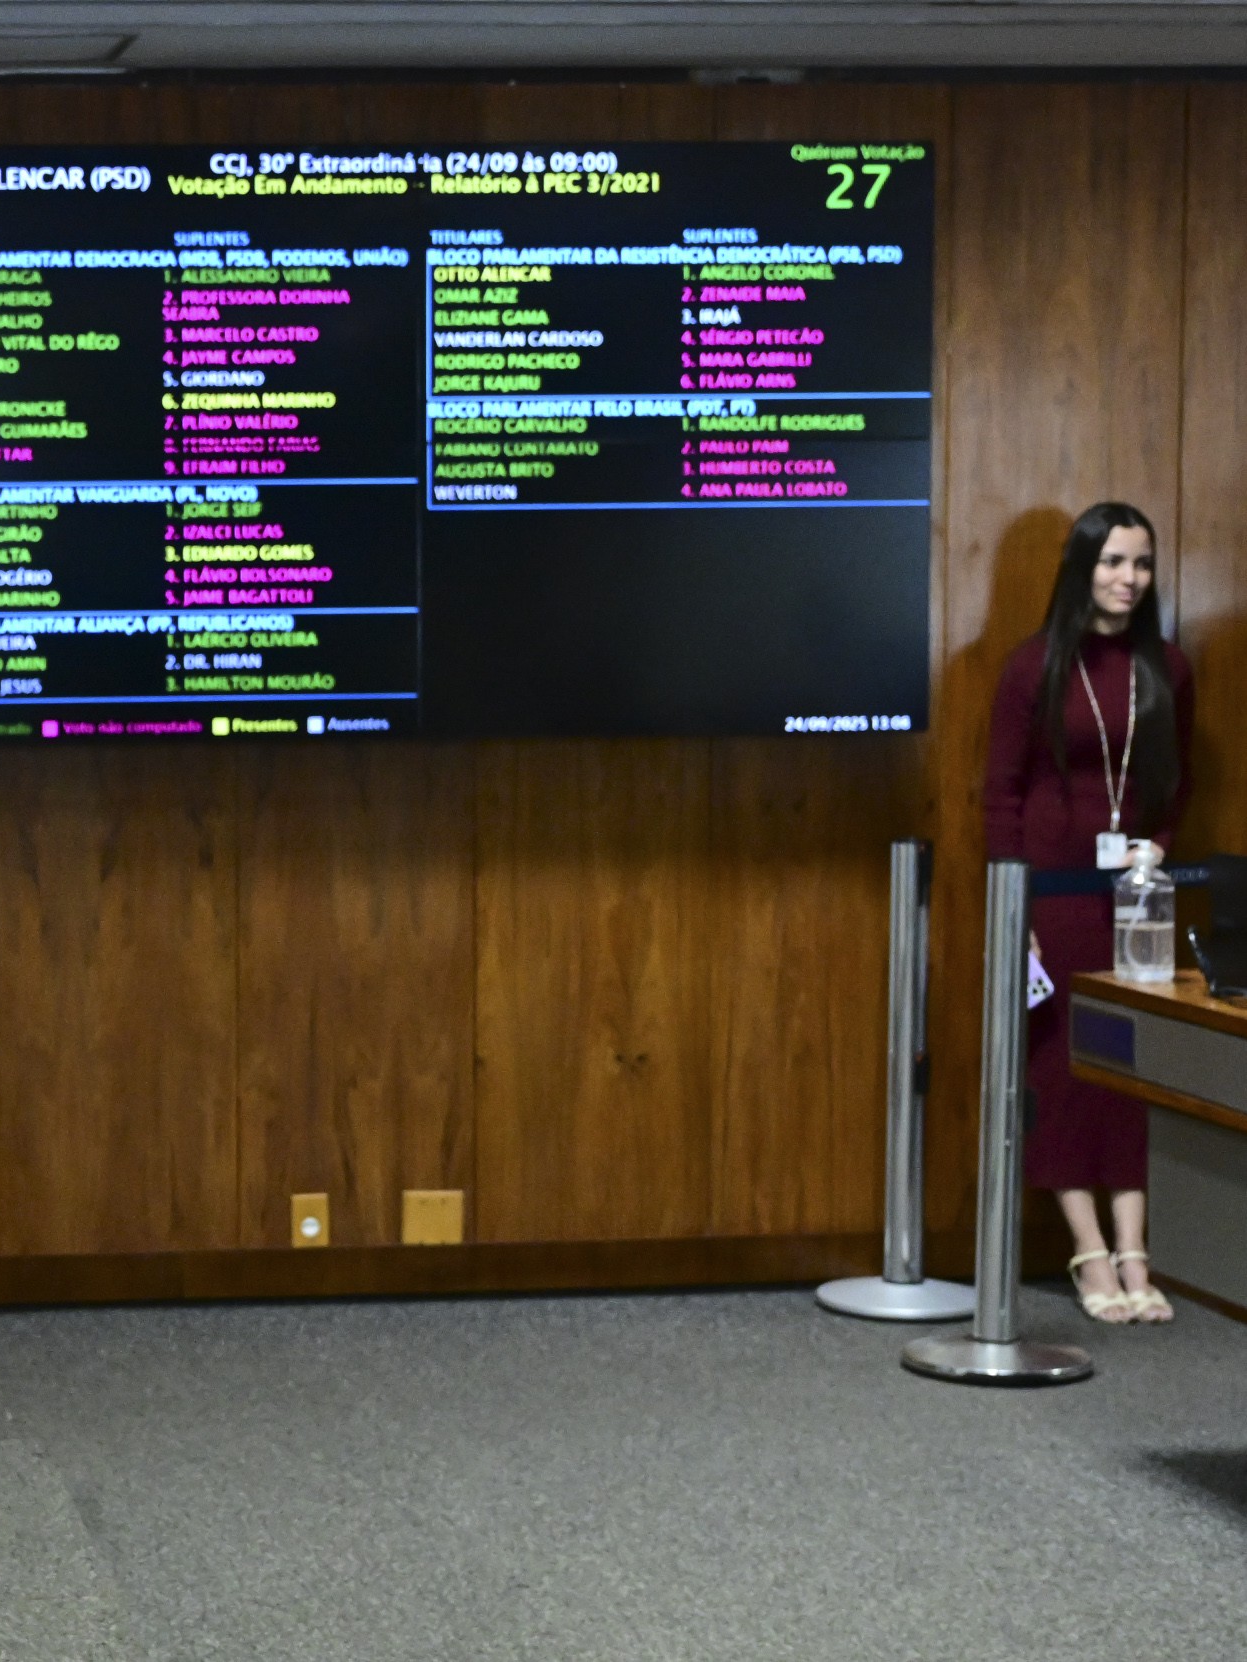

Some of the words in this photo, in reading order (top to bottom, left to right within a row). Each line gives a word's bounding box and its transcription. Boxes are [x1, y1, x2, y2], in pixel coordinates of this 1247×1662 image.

[210, 153, 254, 177] CCJ,
[447, 152, 518, 176] (24/09
[522, 152, 545, 172] às
[550, 151, 618, 174] 09:00)
[90, 167, 151, 192] (PSD)
[168, 175, 251, 199] Votação
[254, 175, 286, 195] Em
[291, 174, 408, 194] Andamento
[431, 174, 522, 194] Relatório
[544, 173, 581, 193] PEC
[587, 172, 660, 196] 3/2021
[826, 163, 892, 210] 27
[174, 232, 250, 246] SUPLENTES
[430, 230, 503, 245] TITULARES
[683, 229, 758, 243] SUPLENTES
[74, 251, 176, 268] DEMOCRACIA
[272, 249, 350, 267] PODEMOS,
[353, 247, 409, 267] UNIÃO)
[426, 248, 480, 265] BLOCO
[483, 248, 593, 265] PARLAMENTAR
[595, 248, 619, 264] DA
[434, 268, 479, 282] OTTO
[481, 266, 551, 282] ALENCAR
[435, 288, 480, 304] OMAR
[2, 336, 46, 350] VITAL
[49, 335, 74, 350] DO
[434, 332, 525, 347] VANDERLAN
[528, 331, 603, 347] CARDOSO
[508, 353, 580, 369] PACHECO
[428, 402, 480, 417] BLOCO
[483, 402, 591, 417] PARLAMENTAR
[594, 401, 633, 416] PELO
[77, 487, 173, 503] VANGUARDA
[214, 654, 262, 669] HIRAN
